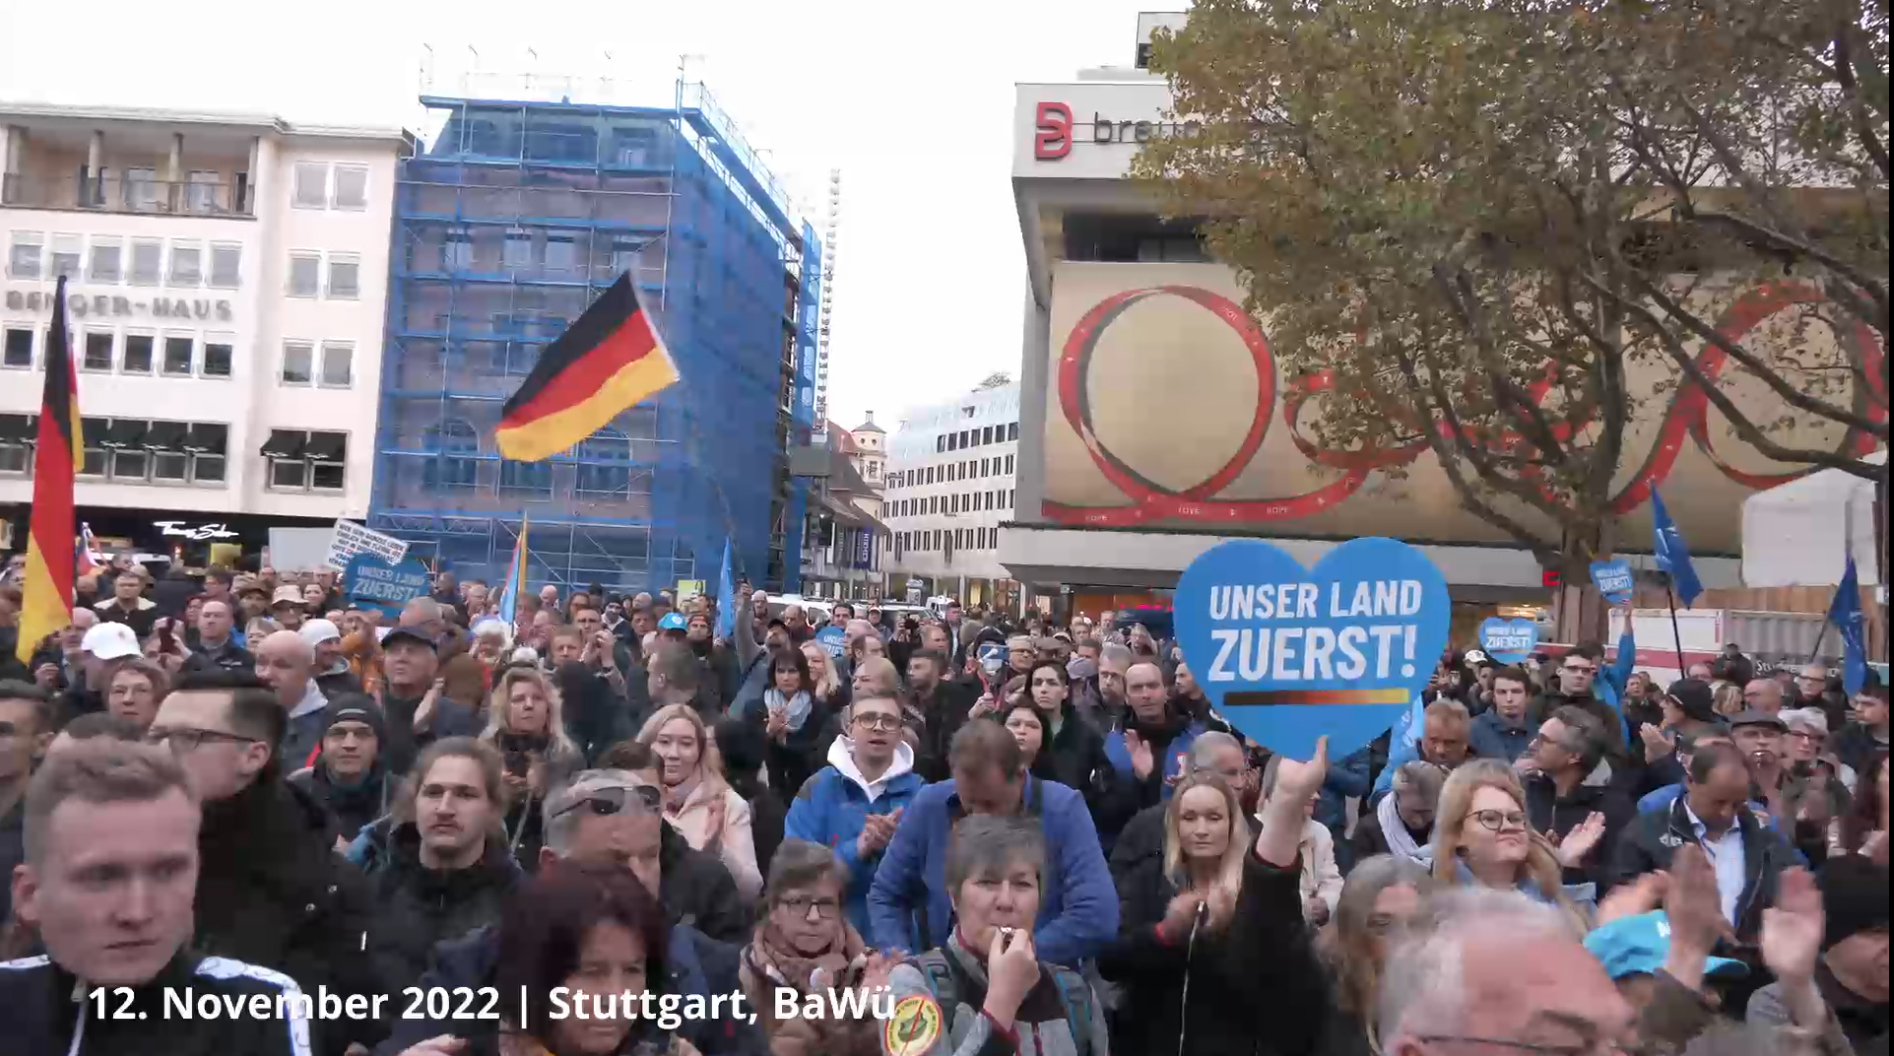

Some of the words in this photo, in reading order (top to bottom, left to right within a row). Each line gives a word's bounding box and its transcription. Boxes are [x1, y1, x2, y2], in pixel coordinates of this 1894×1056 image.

[357, 565, 393, 581] UNSER
[1209, 582, 1320, 621] UNSER
[1329, 579, 1423, 618] LAND
[1207, 624, 1418, 682] ZUERST!
